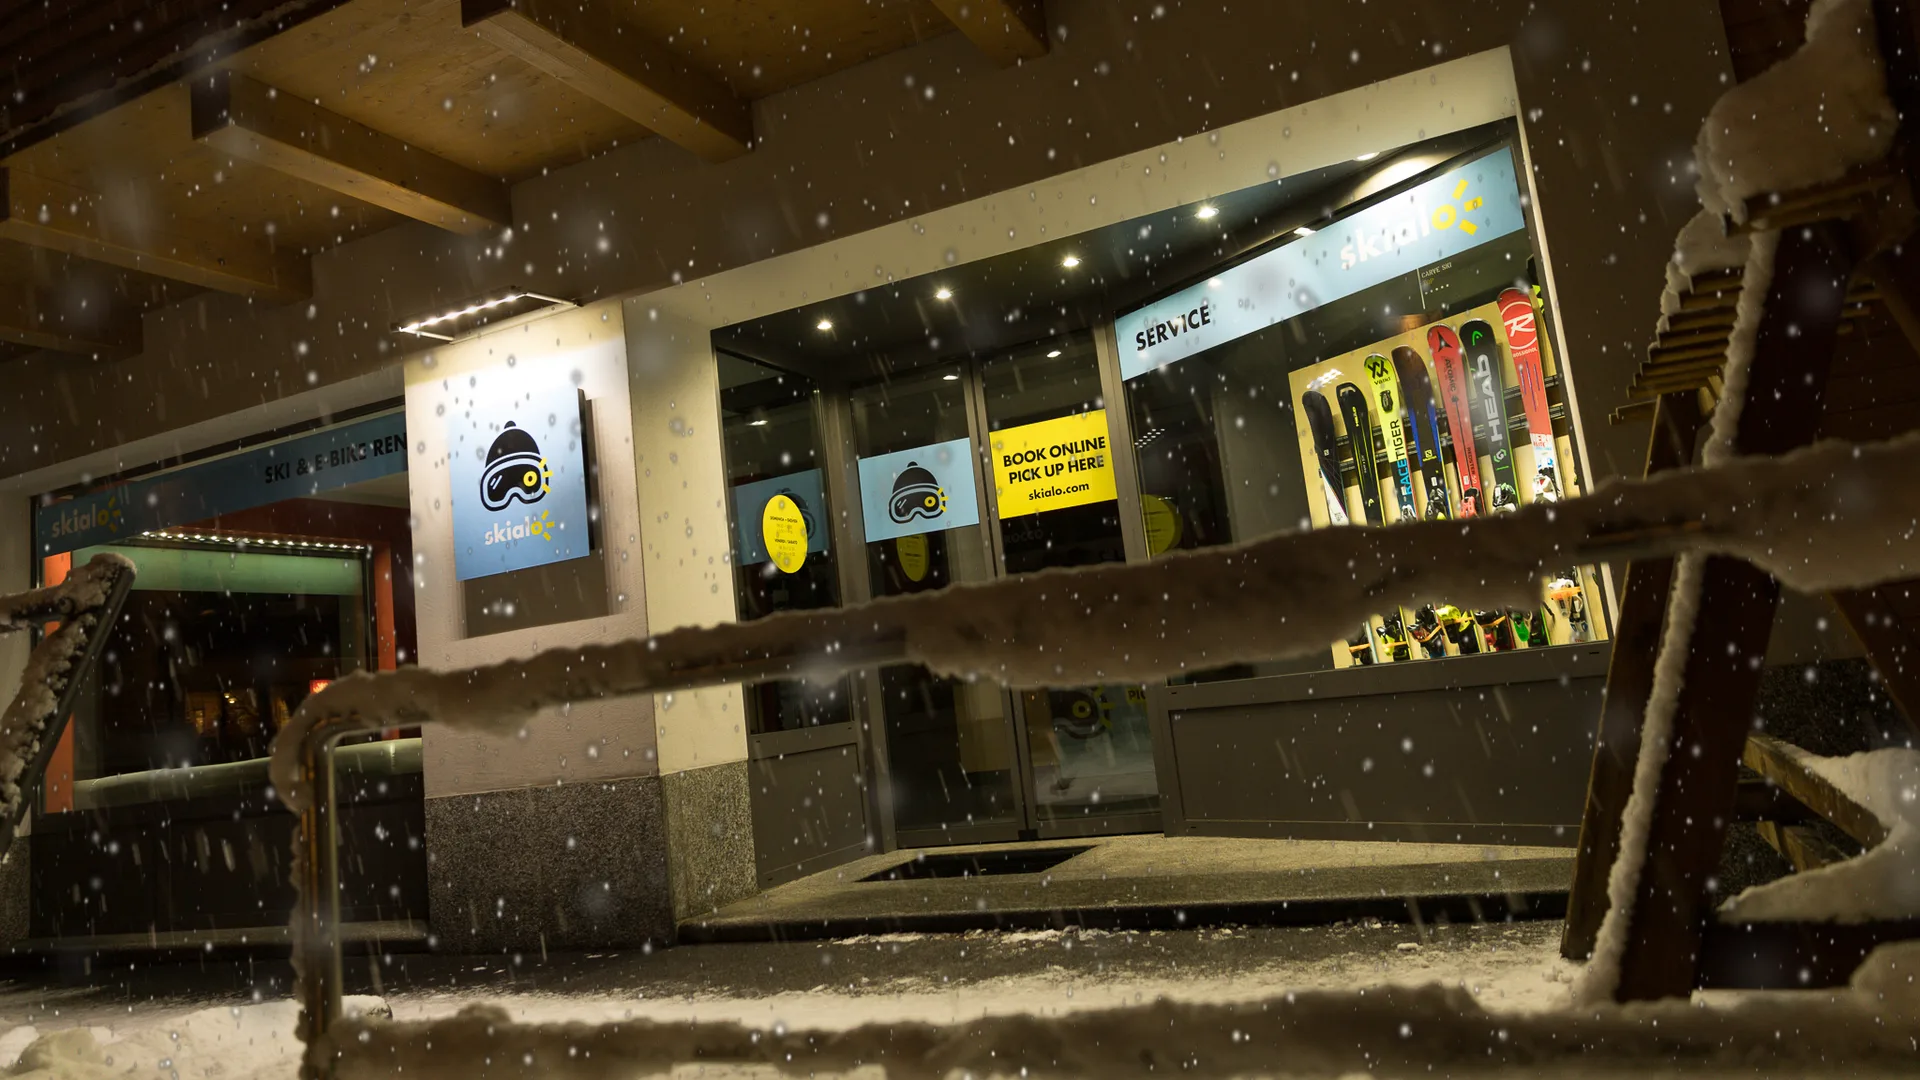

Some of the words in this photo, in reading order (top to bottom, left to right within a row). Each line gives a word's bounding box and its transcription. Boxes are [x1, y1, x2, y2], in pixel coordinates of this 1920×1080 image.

[1339, 203, 1457, 270] skialo
[1421, 266, 1440, 278] CARVE
[1441, 262, 1452, 271] SKI
[1135, 305, 1211, 351] SERVICE
[1477, 354, 1503, 443] HEAD
[1003, 447, 1047, 468] BOOK
[1049, 436, 1106, 459] ONLINE
[265, 462, 290, 484] SKI
[297, 458, 309, 476] &
[1009, 467, 1042, 485] PICK
[1044, 463, 1064, 477] UP
[1068, 455, 1105, 474] HERE
[1028, 483, 1090, 501] skialo.com
[51, 502, 110, 538] skialo
[485, 516, 543, 545] skialo
